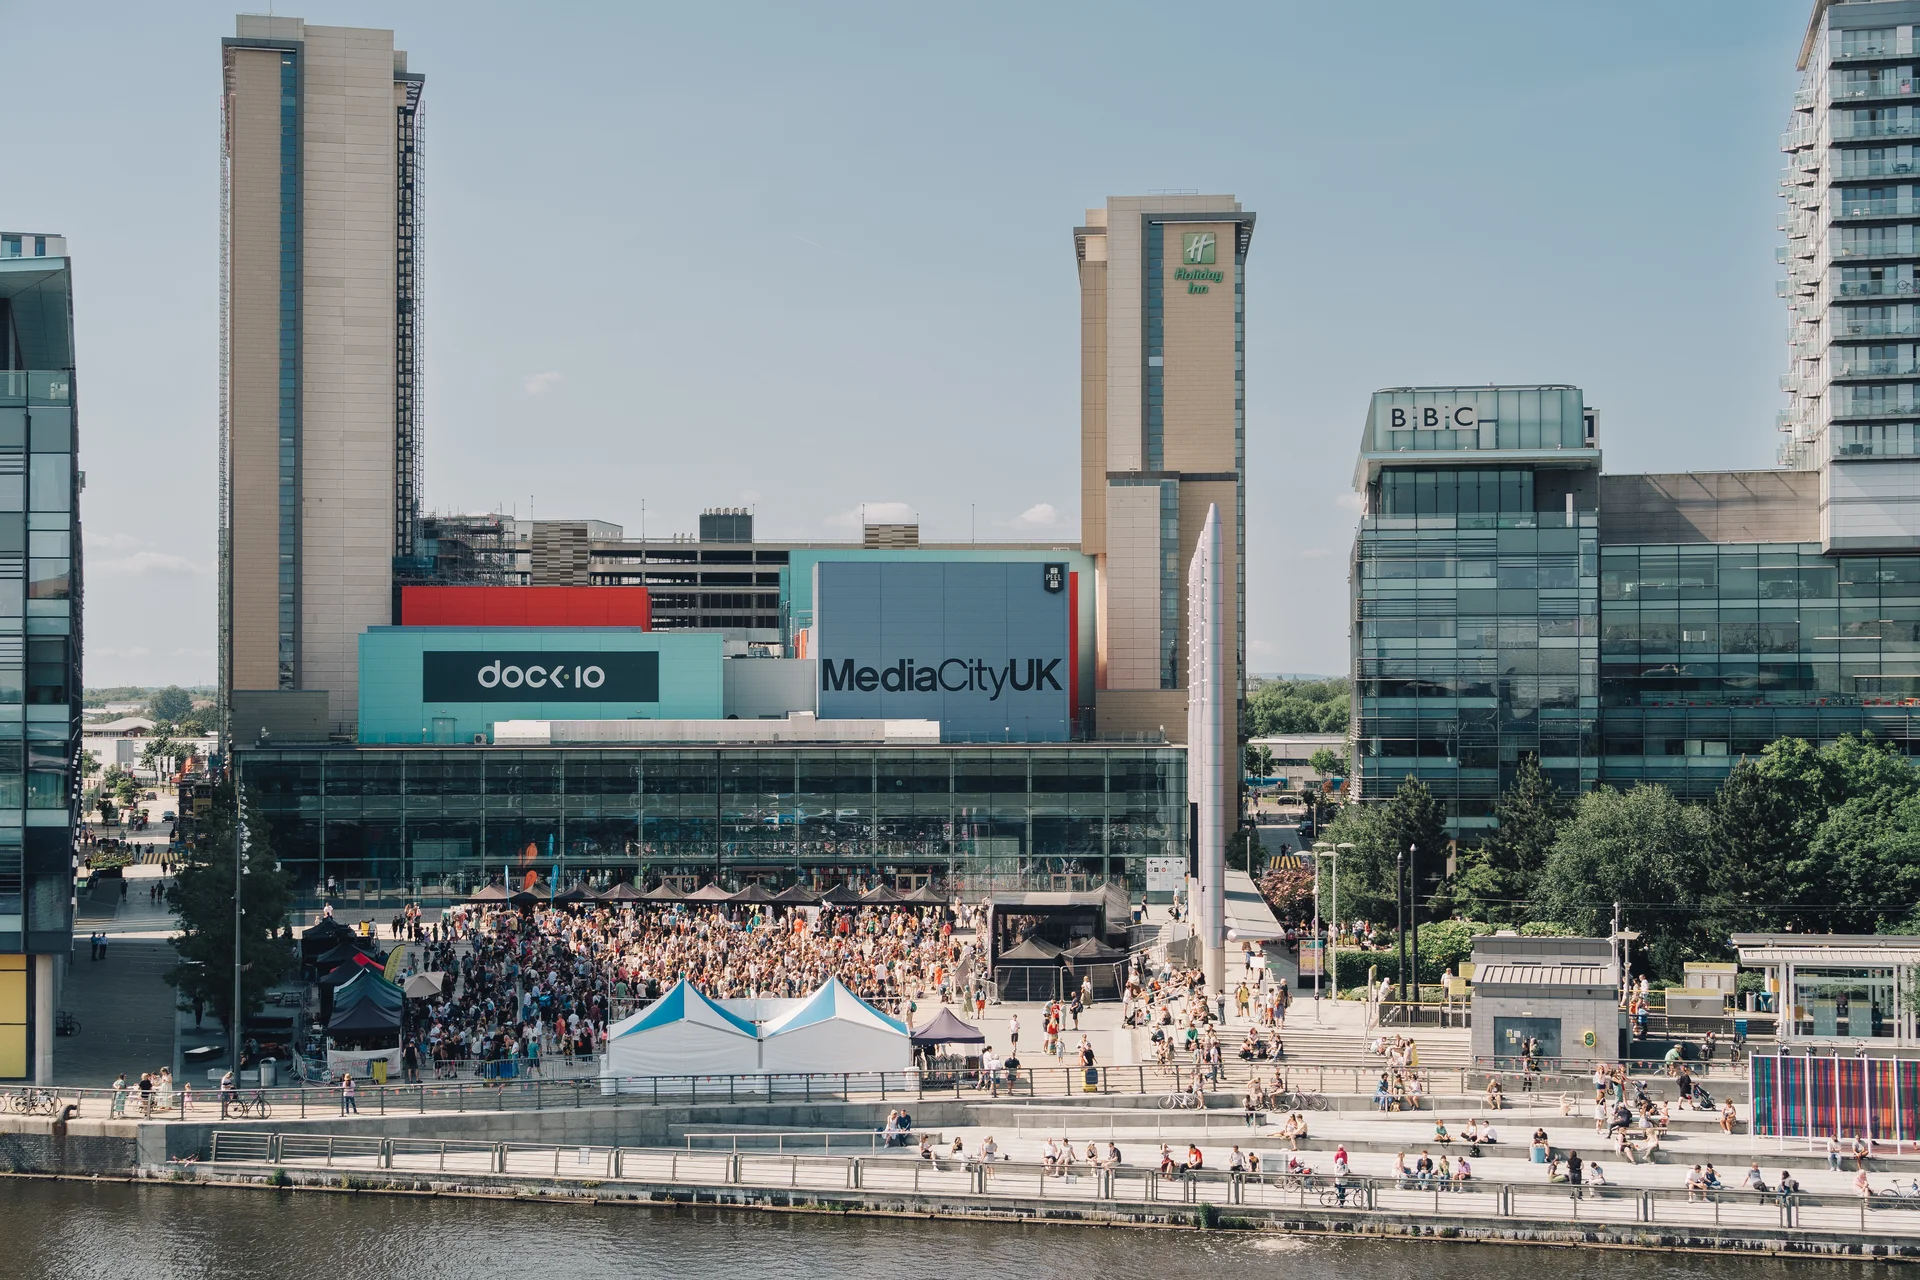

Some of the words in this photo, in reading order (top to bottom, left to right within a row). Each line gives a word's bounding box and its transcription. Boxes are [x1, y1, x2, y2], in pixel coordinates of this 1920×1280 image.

[1174, 267, 1224, 283] Holiday
[1187, 281, 1209, 294] Inn
[1391, 406, 1474, 428] BBC
[1045, 573, 1063, 581] PEEL
[822, 658, 1064, 701] MediaCityUK
